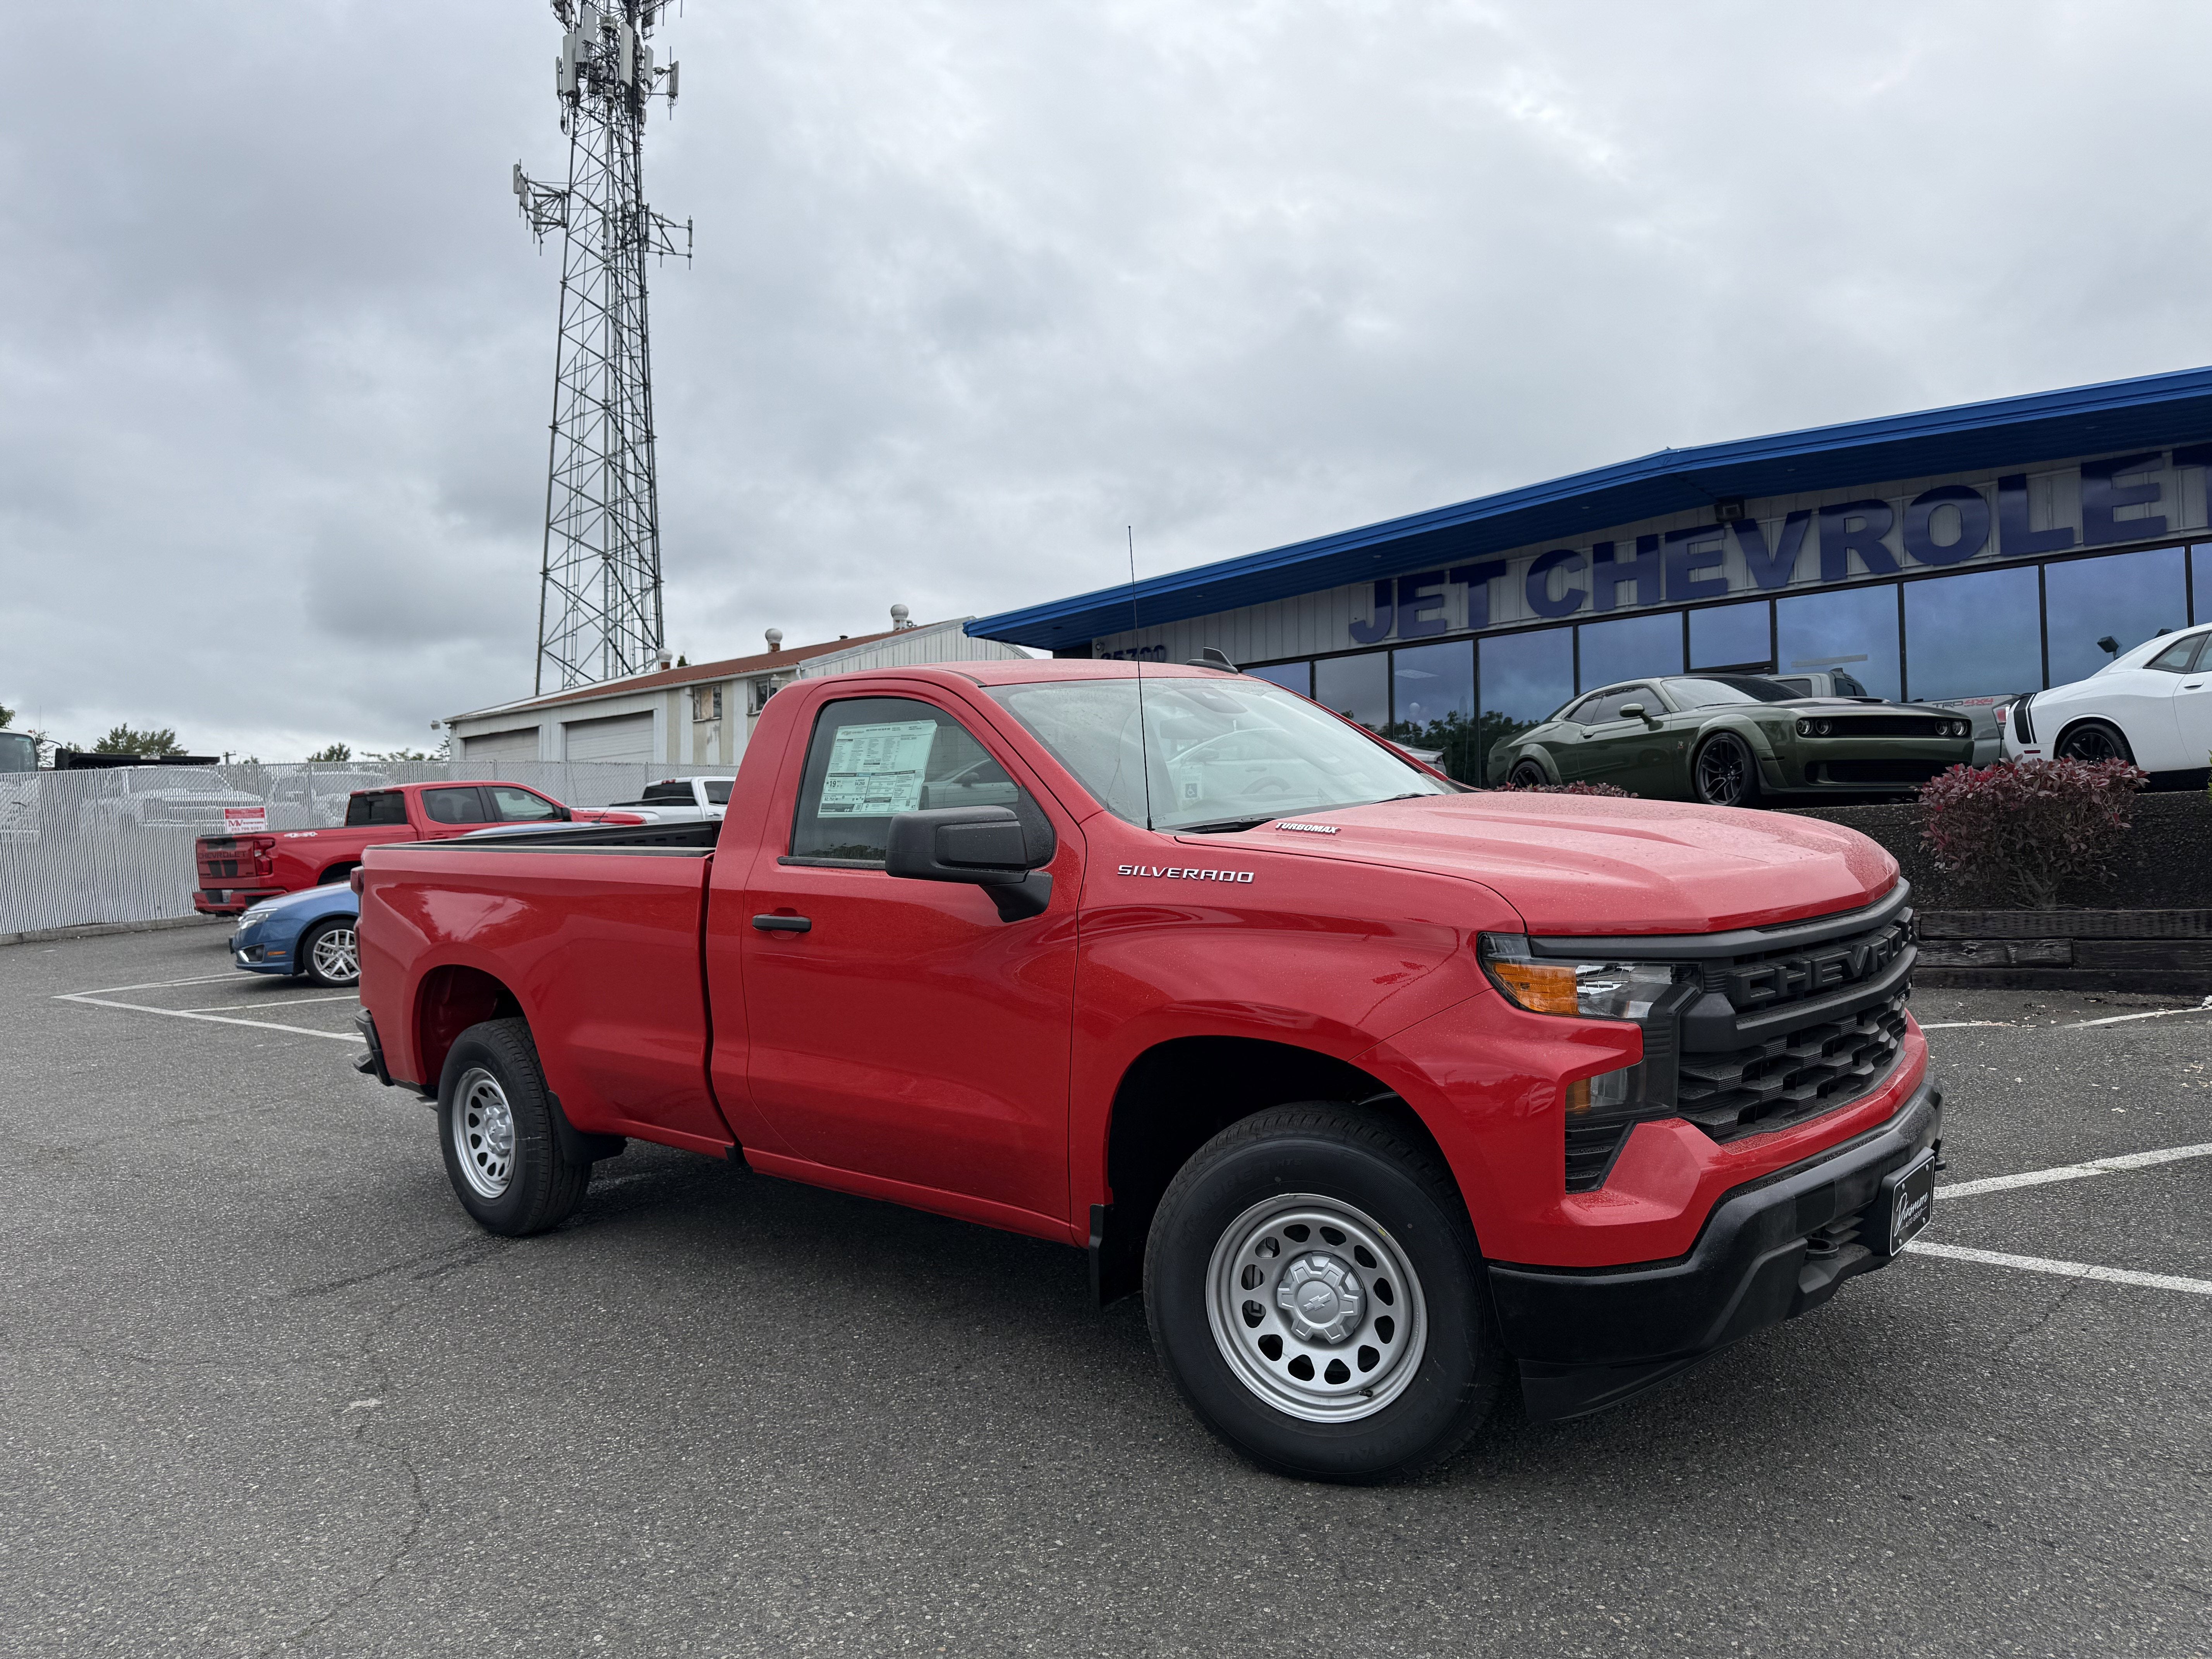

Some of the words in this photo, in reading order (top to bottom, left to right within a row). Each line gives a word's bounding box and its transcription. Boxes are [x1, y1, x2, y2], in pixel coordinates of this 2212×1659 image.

[1348, 559, 1507, 644] JET
[1275, 822, 1341, 835] TURBOMAX
[198, 850, 247, 859] CHEVROLET
[1117, 864, 1255, 883] SILVERADO
[1726, 907, 1913, 1008] CHEVROLE
